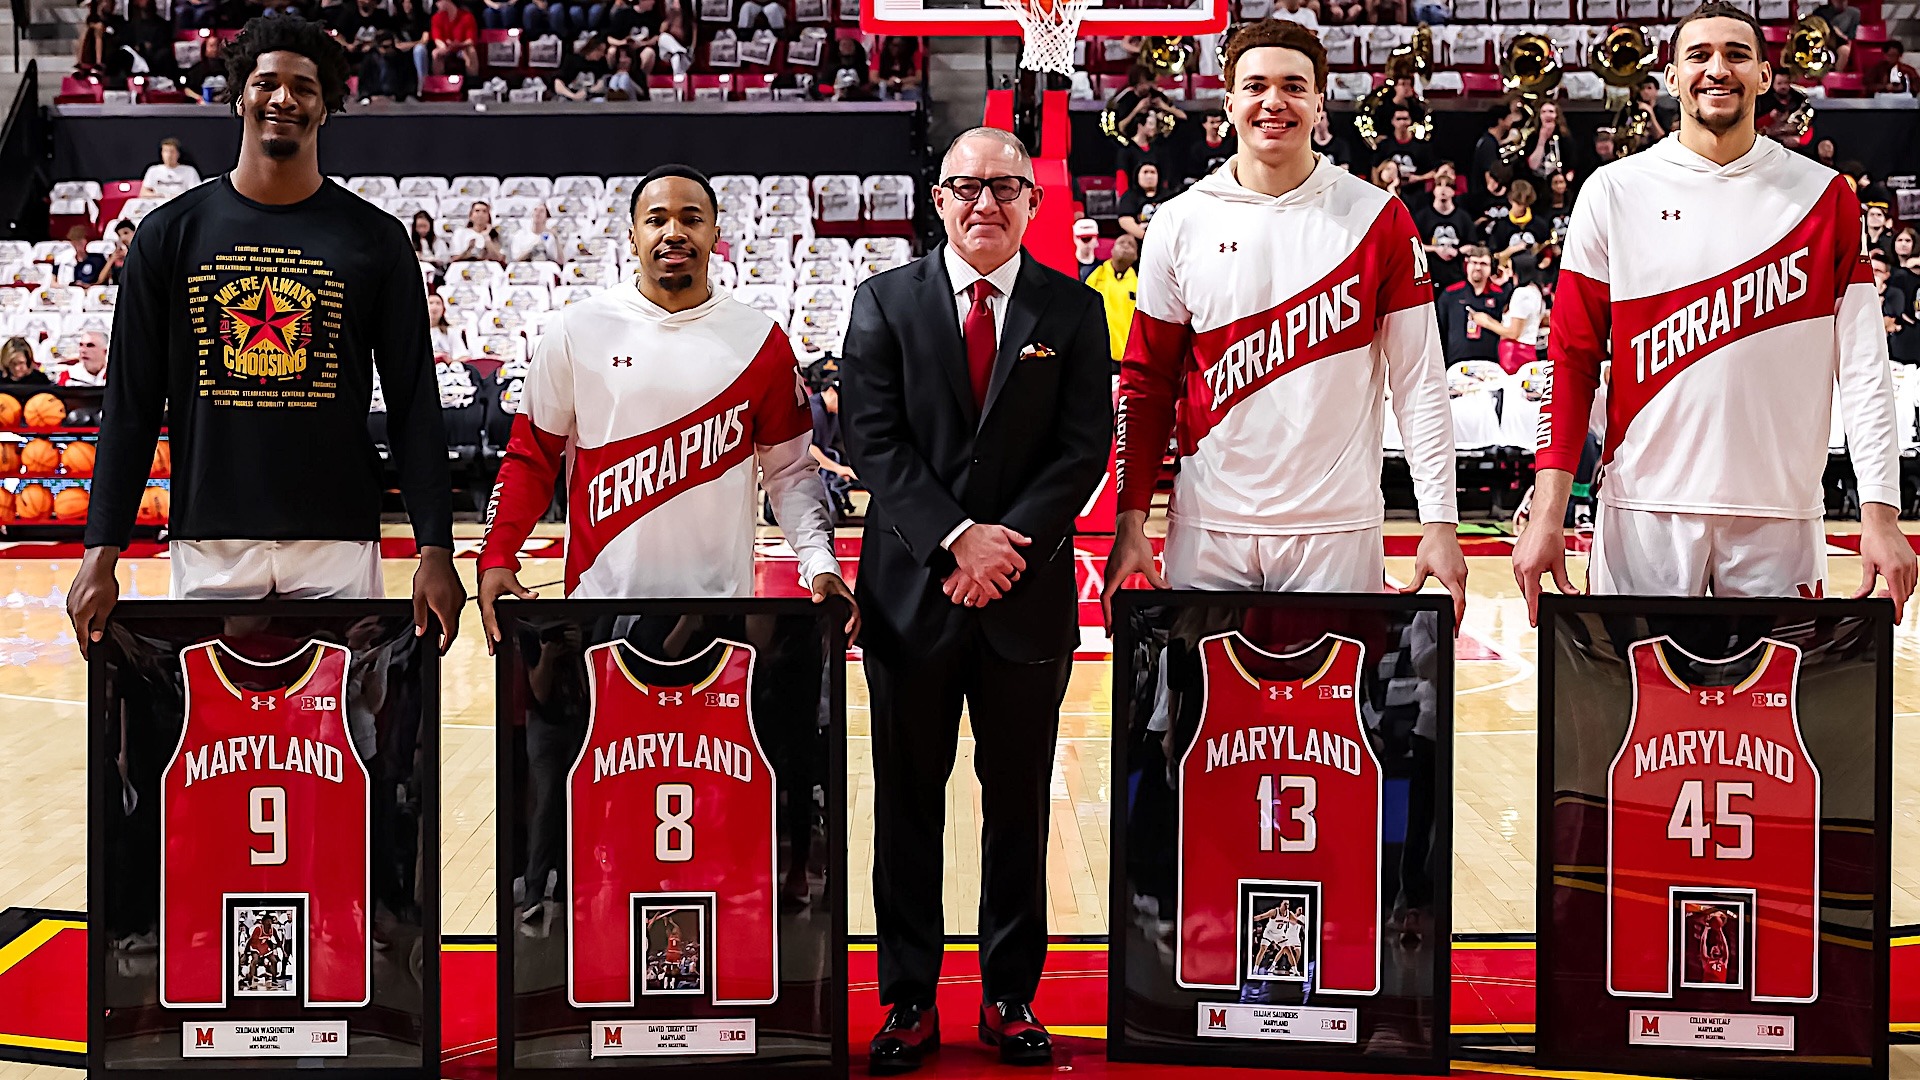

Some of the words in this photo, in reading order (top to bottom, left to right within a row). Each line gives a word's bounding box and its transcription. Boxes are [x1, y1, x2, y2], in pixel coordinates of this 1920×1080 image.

[214, 276, 260, 305] WE'RE
[1631, 246, 1809, 384] TERRAPINS
[220, 320, 229, 330] 20
[1203, 274, 1360, 412] TERRAPINS
[224, 344, 306, 377] CHOOSING
[588, 400, 749, 527] TERRAPINS
[185, 735, 343, 787] MARYLAND
[593, 732, 751, 784] MARYLAND
[1205, 725, 1360, 776] MARYLAND
[1634, 730, 1794, 784] MARYLAND
[250, 786, 286, 865] 9
[656, 783, 693, 862] 8
[1256, 775, 1317, 852] 13
[1667, 780, 1753, 859] 45
[1273, 1011, 1298, 1019] SAUNDERS
